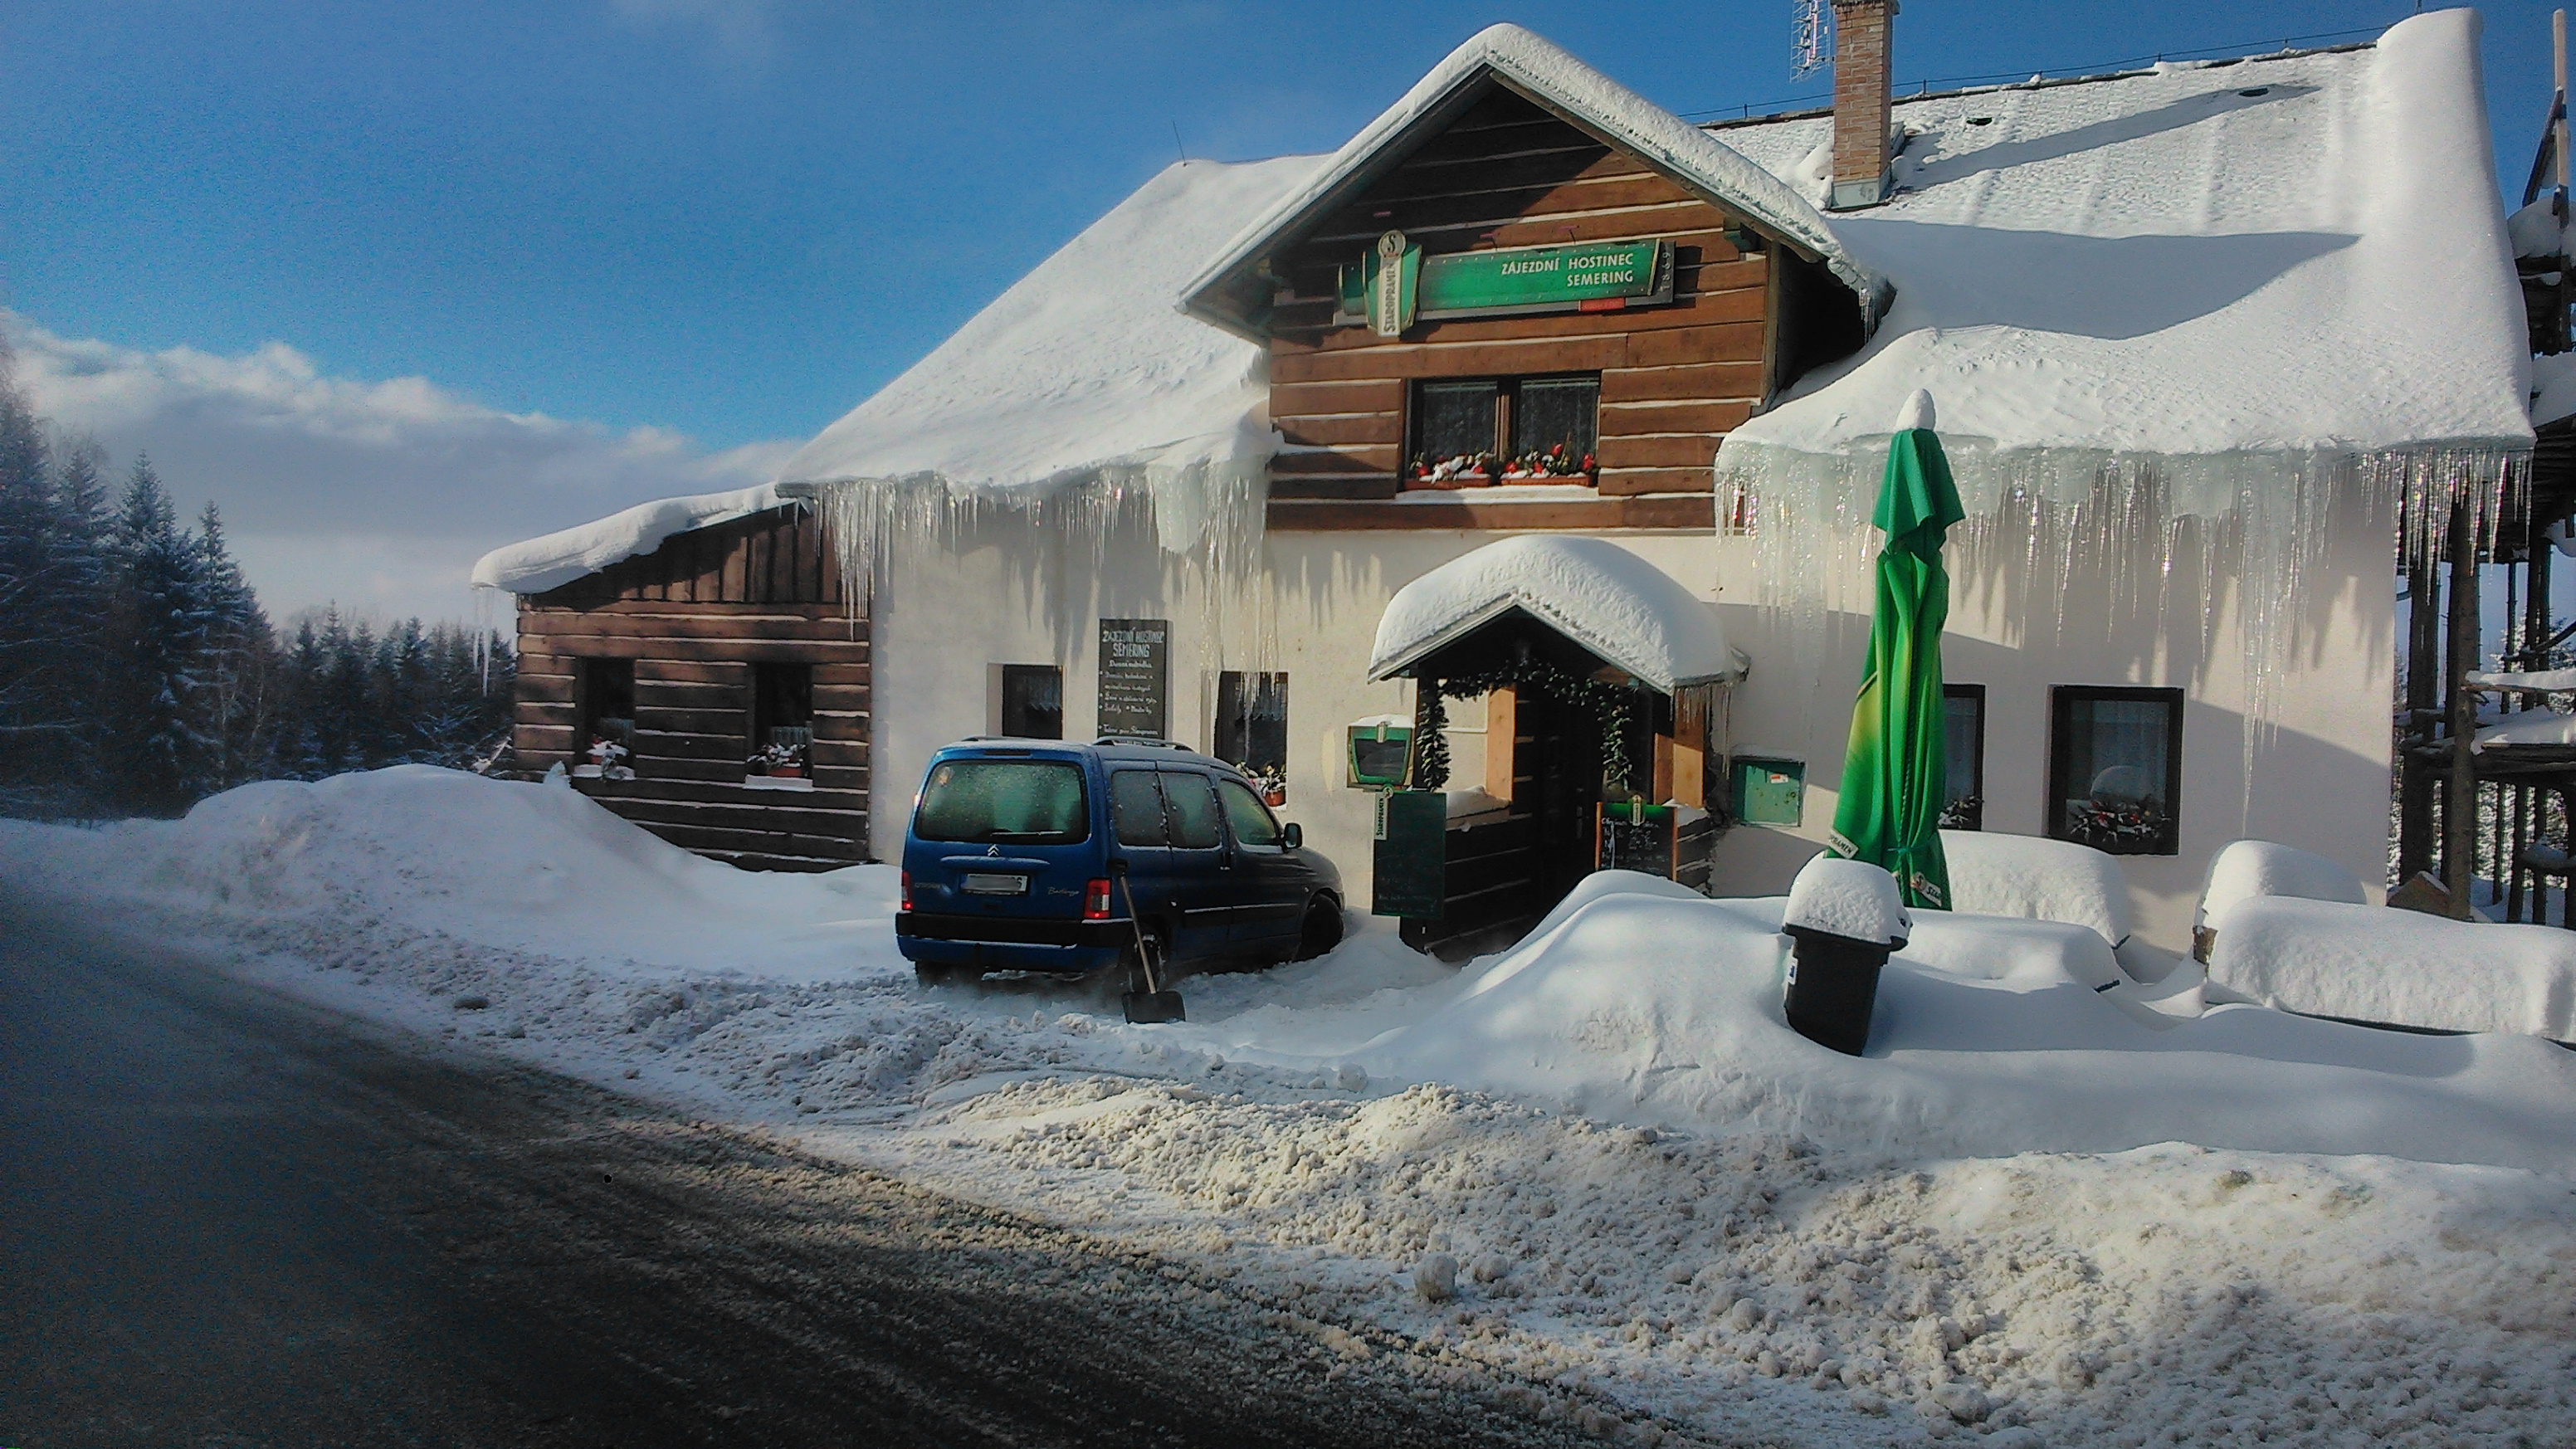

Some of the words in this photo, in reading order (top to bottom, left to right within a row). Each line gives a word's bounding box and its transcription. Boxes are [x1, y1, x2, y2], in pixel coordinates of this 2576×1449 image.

[1501, 257, 1560, 275] ZÁJEZDNÍ
[1568, 253, 1633, 270] HOSTINEC
[1567, 270, 1633, 287] SEMERING
[1113, 642, 1150, 657] SEMERING
